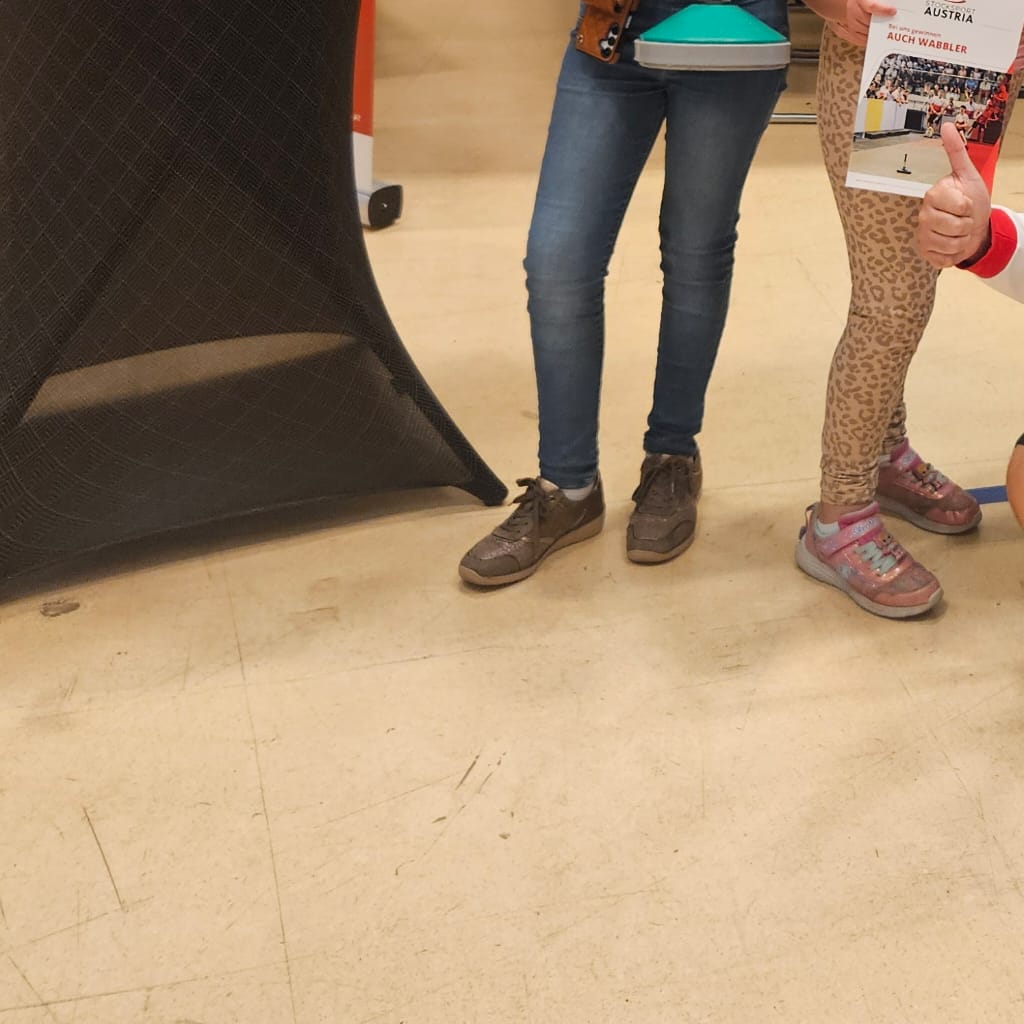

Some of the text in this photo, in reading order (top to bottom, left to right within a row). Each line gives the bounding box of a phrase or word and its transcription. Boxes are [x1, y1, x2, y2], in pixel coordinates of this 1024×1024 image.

[924, 7, 974, 24] AUSTRIA
[926, 0, 976, 14] STOCKSPORT
[887, 32, 968, 54] AUCH WABBLER
